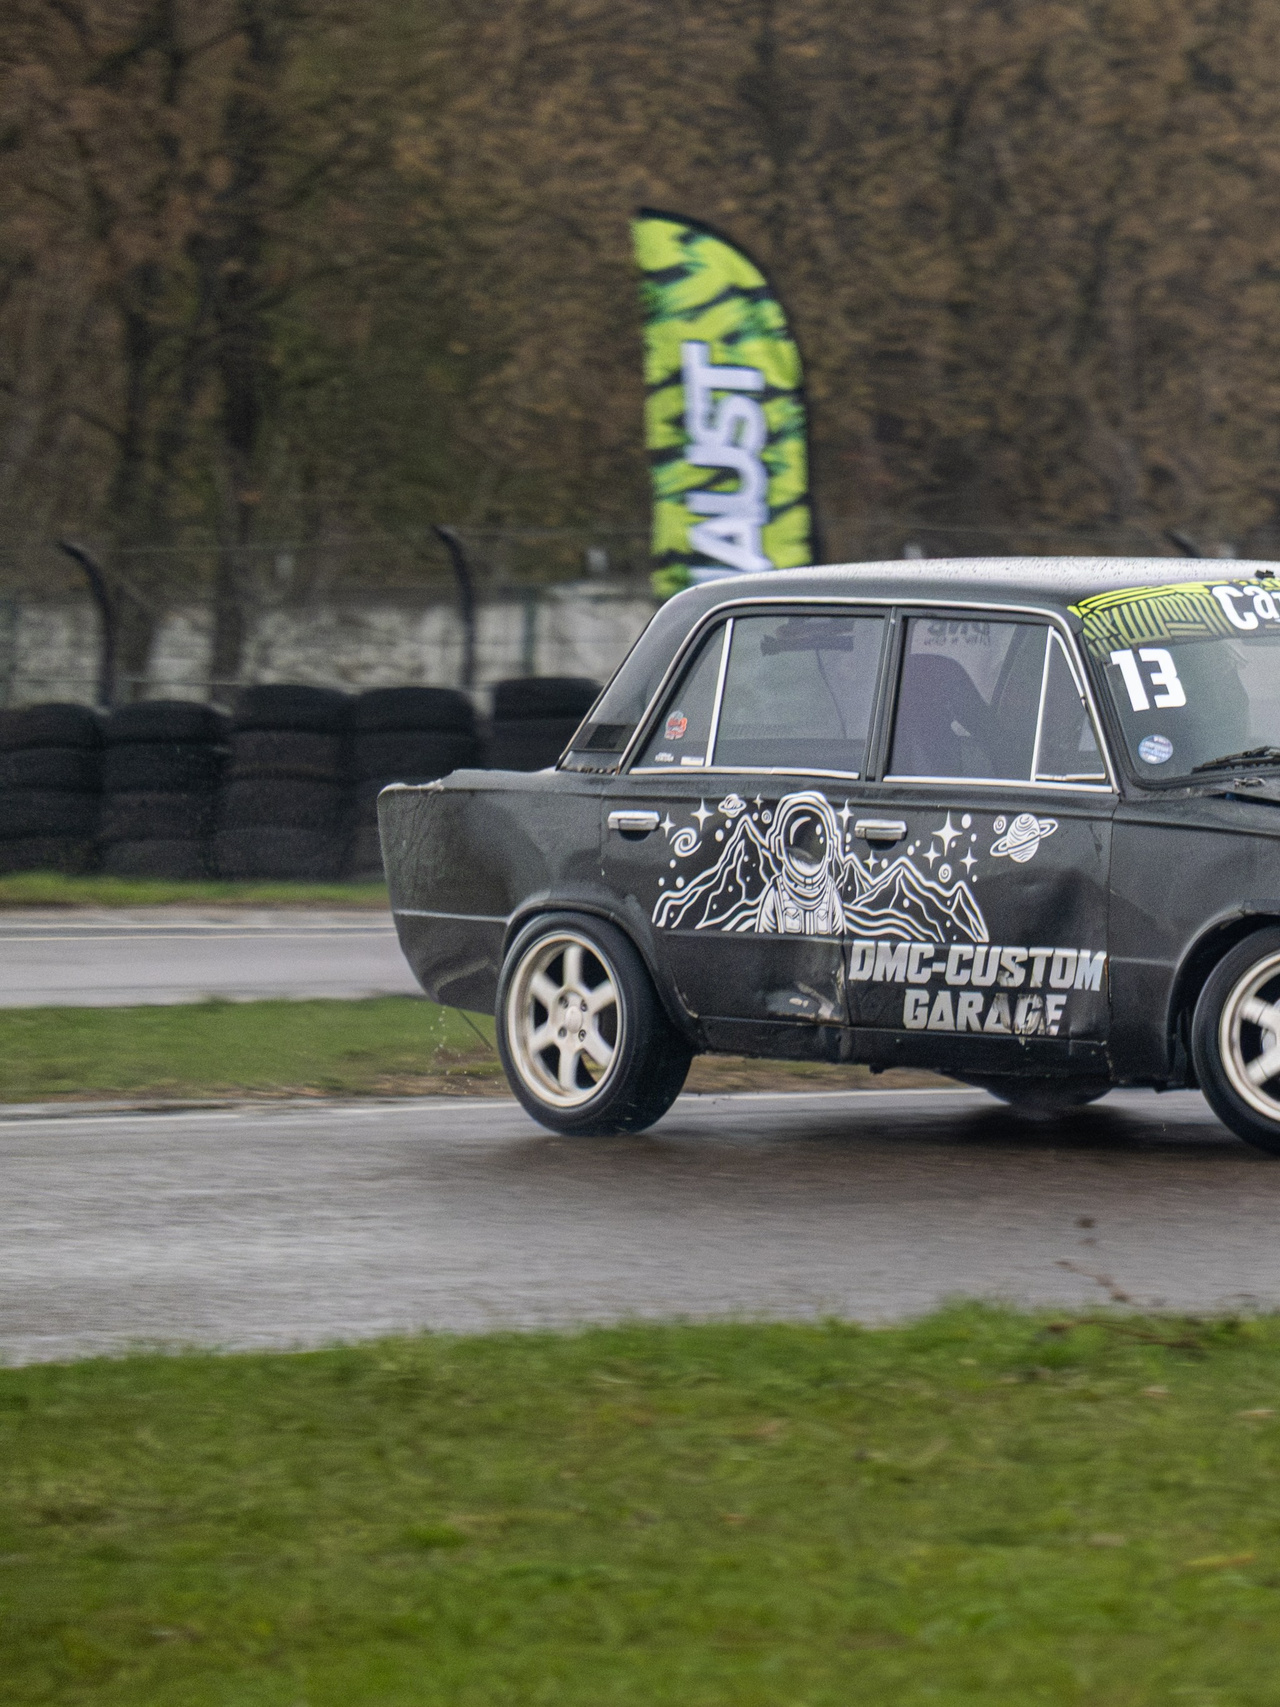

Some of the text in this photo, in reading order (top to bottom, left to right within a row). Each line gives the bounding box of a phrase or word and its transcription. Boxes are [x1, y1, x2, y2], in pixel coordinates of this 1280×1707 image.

[681, 340, 772, 582] AUST
[1110, 648, 1186, 712] 13
[848, 938, 1107, 992] DMC-CUSTOM
[902, 988, 1067, 1036] GARAGE
